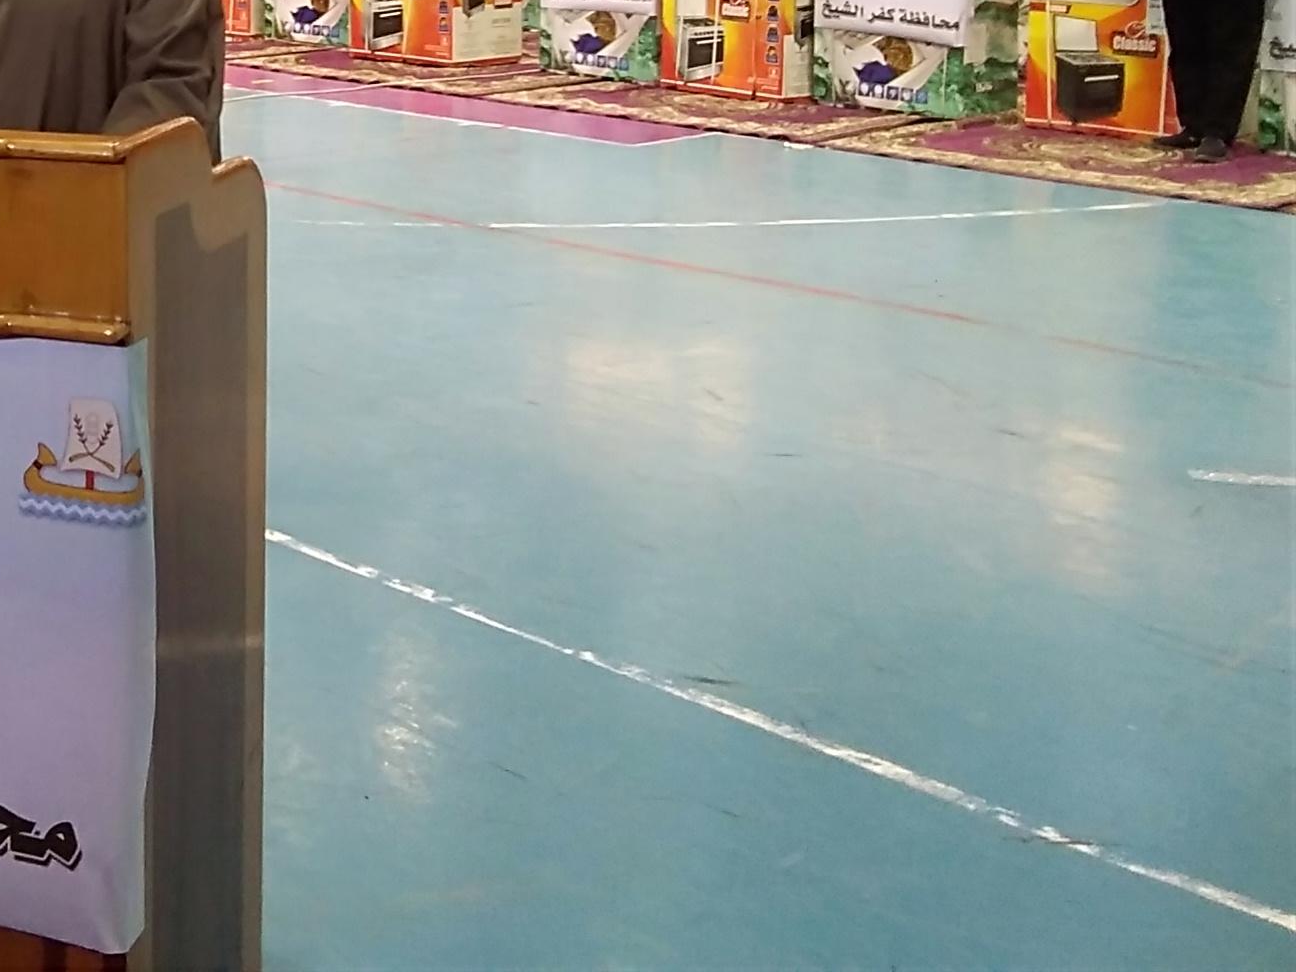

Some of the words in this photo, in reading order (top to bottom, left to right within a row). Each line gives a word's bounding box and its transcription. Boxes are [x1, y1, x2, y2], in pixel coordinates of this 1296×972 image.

[821, 0, 864, 20] الشيخ
[867, 6, 897, 24] كفر
[899, 8, 961, 31] محافظة
